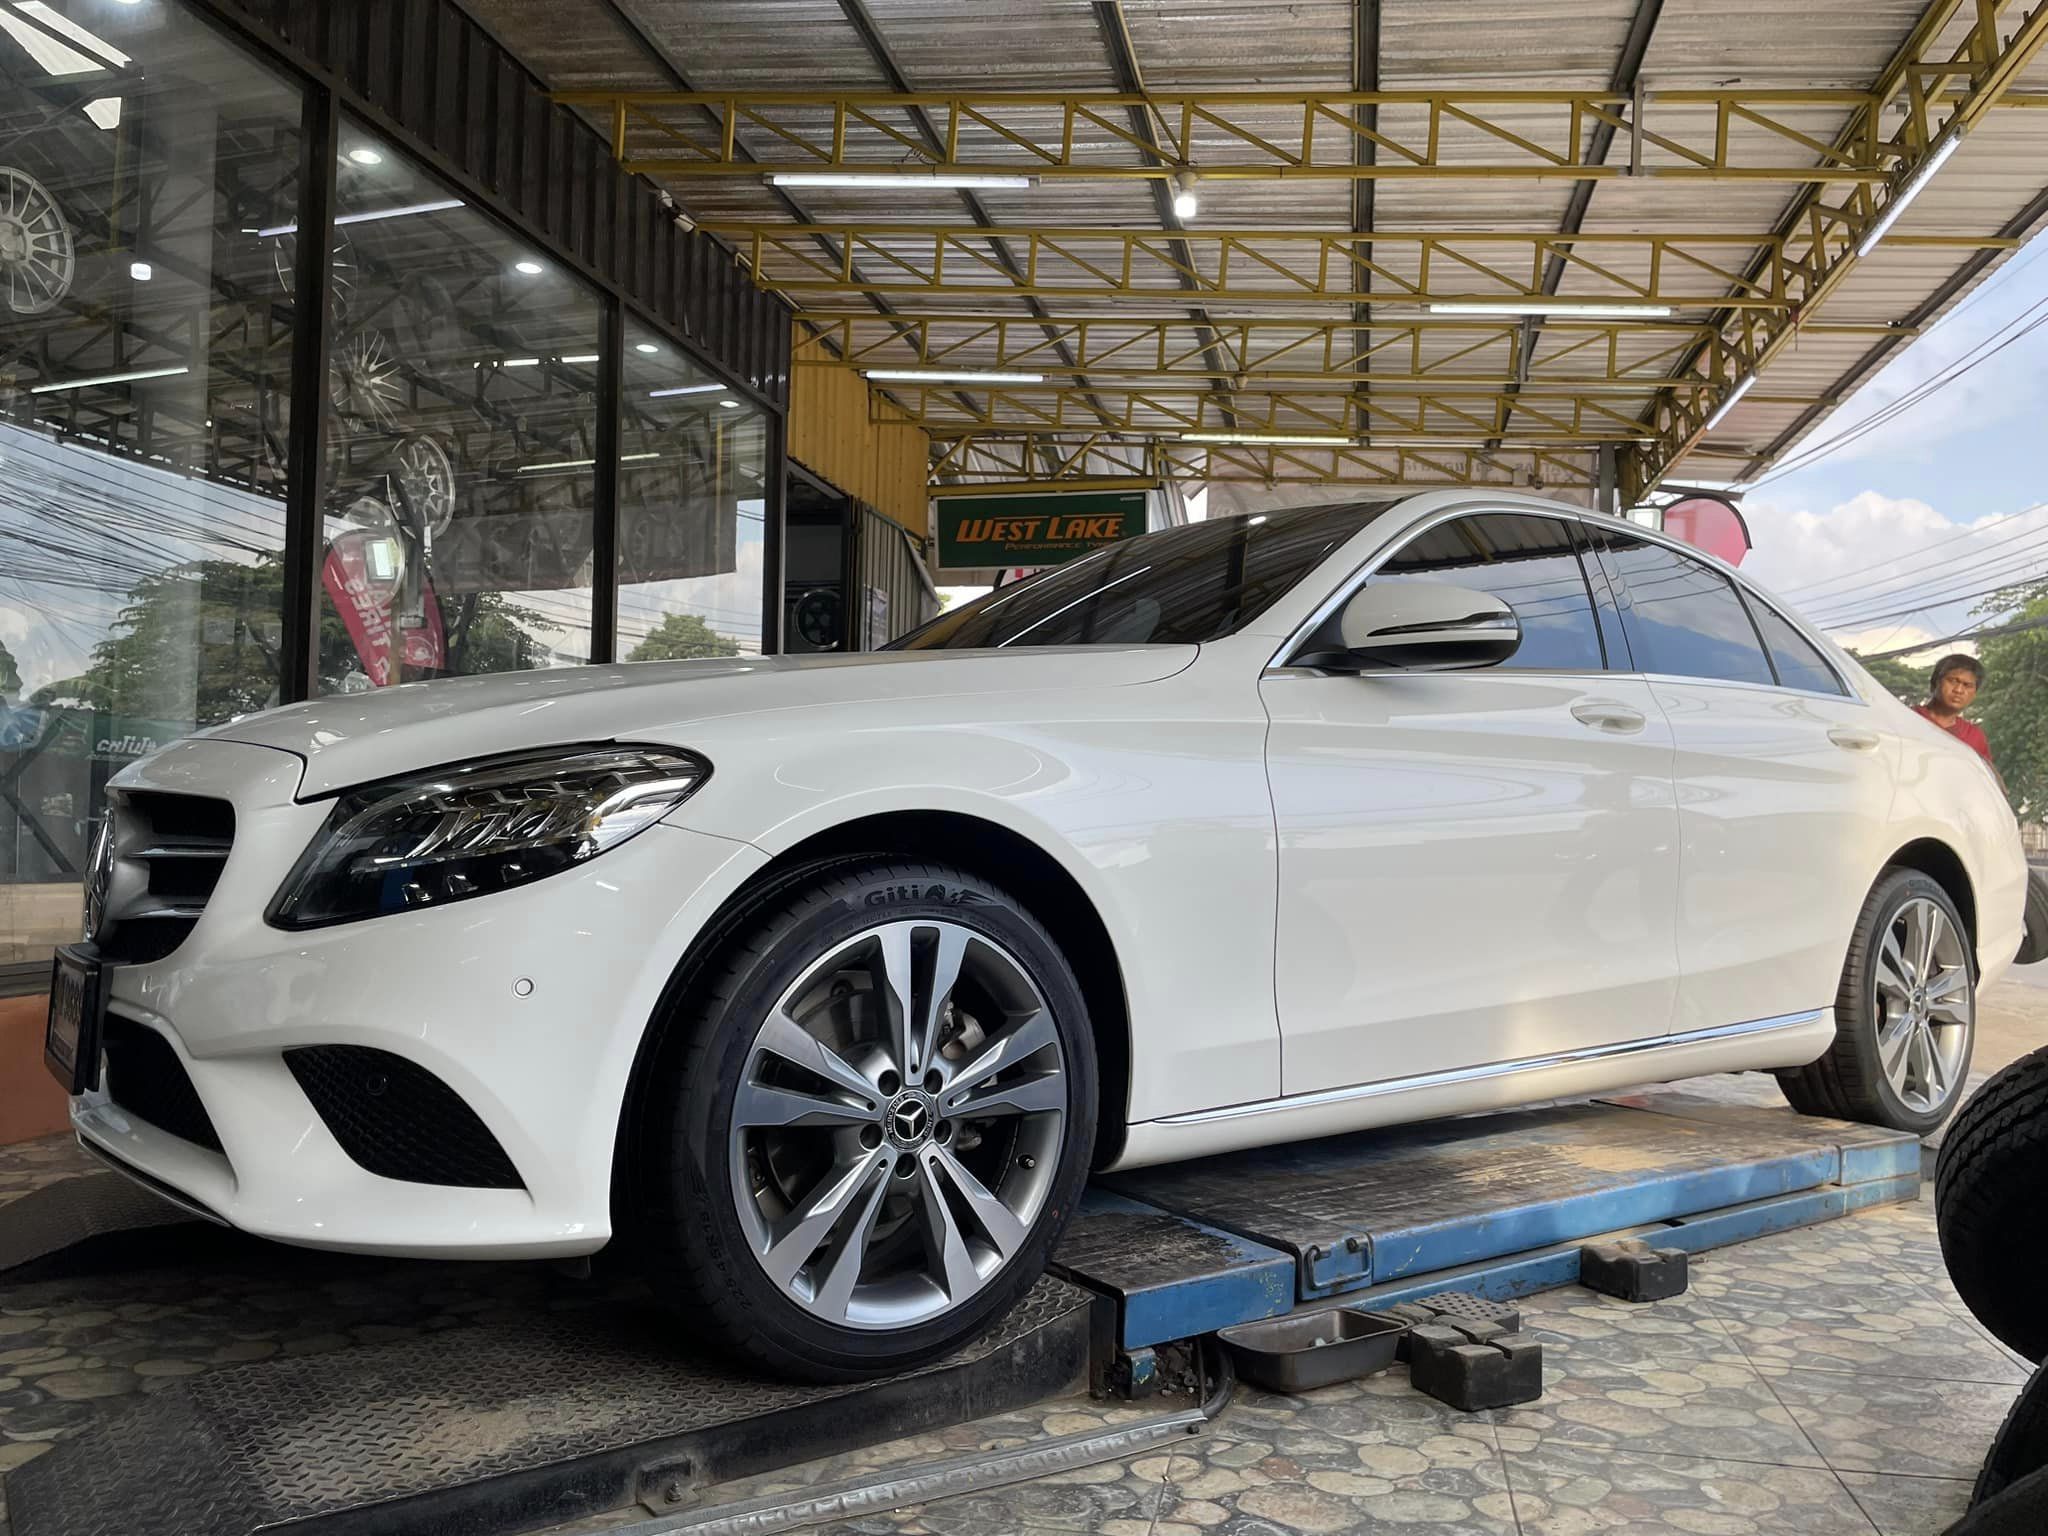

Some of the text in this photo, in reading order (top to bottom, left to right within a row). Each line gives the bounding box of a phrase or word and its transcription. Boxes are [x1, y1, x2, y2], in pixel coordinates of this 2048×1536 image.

[956, 516, 1123, 542] WEST LAKE
[864, 884, 919, 905] Giti
